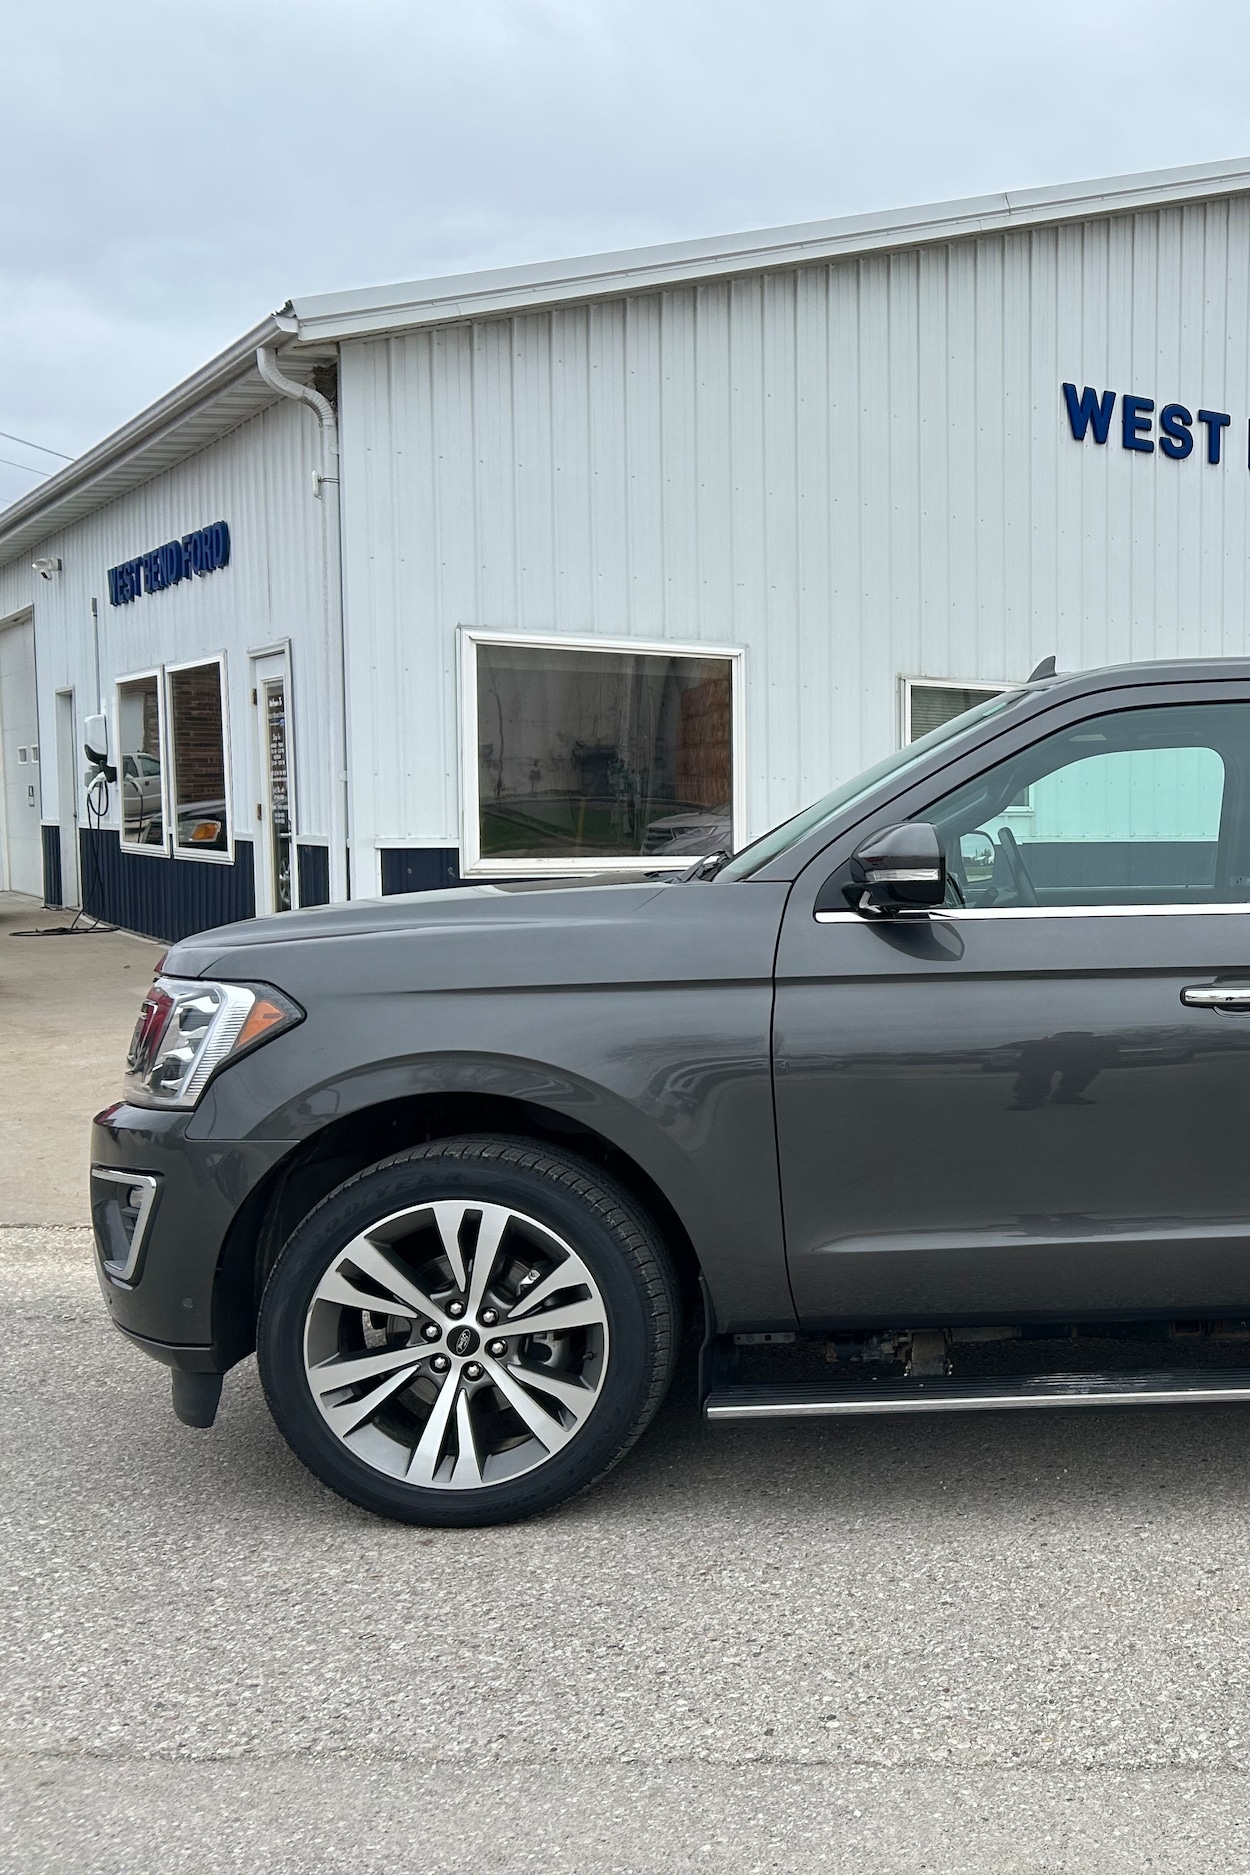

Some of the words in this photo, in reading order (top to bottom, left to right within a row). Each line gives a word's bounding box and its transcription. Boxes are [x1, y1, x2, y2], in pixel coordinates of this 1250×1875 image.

[1062, 382, 1231, 465] WEST
[107, 555, 142, 606] WEST
[143, 540, 182, 595] BEND
[182, 520, 230, 580] FORD
